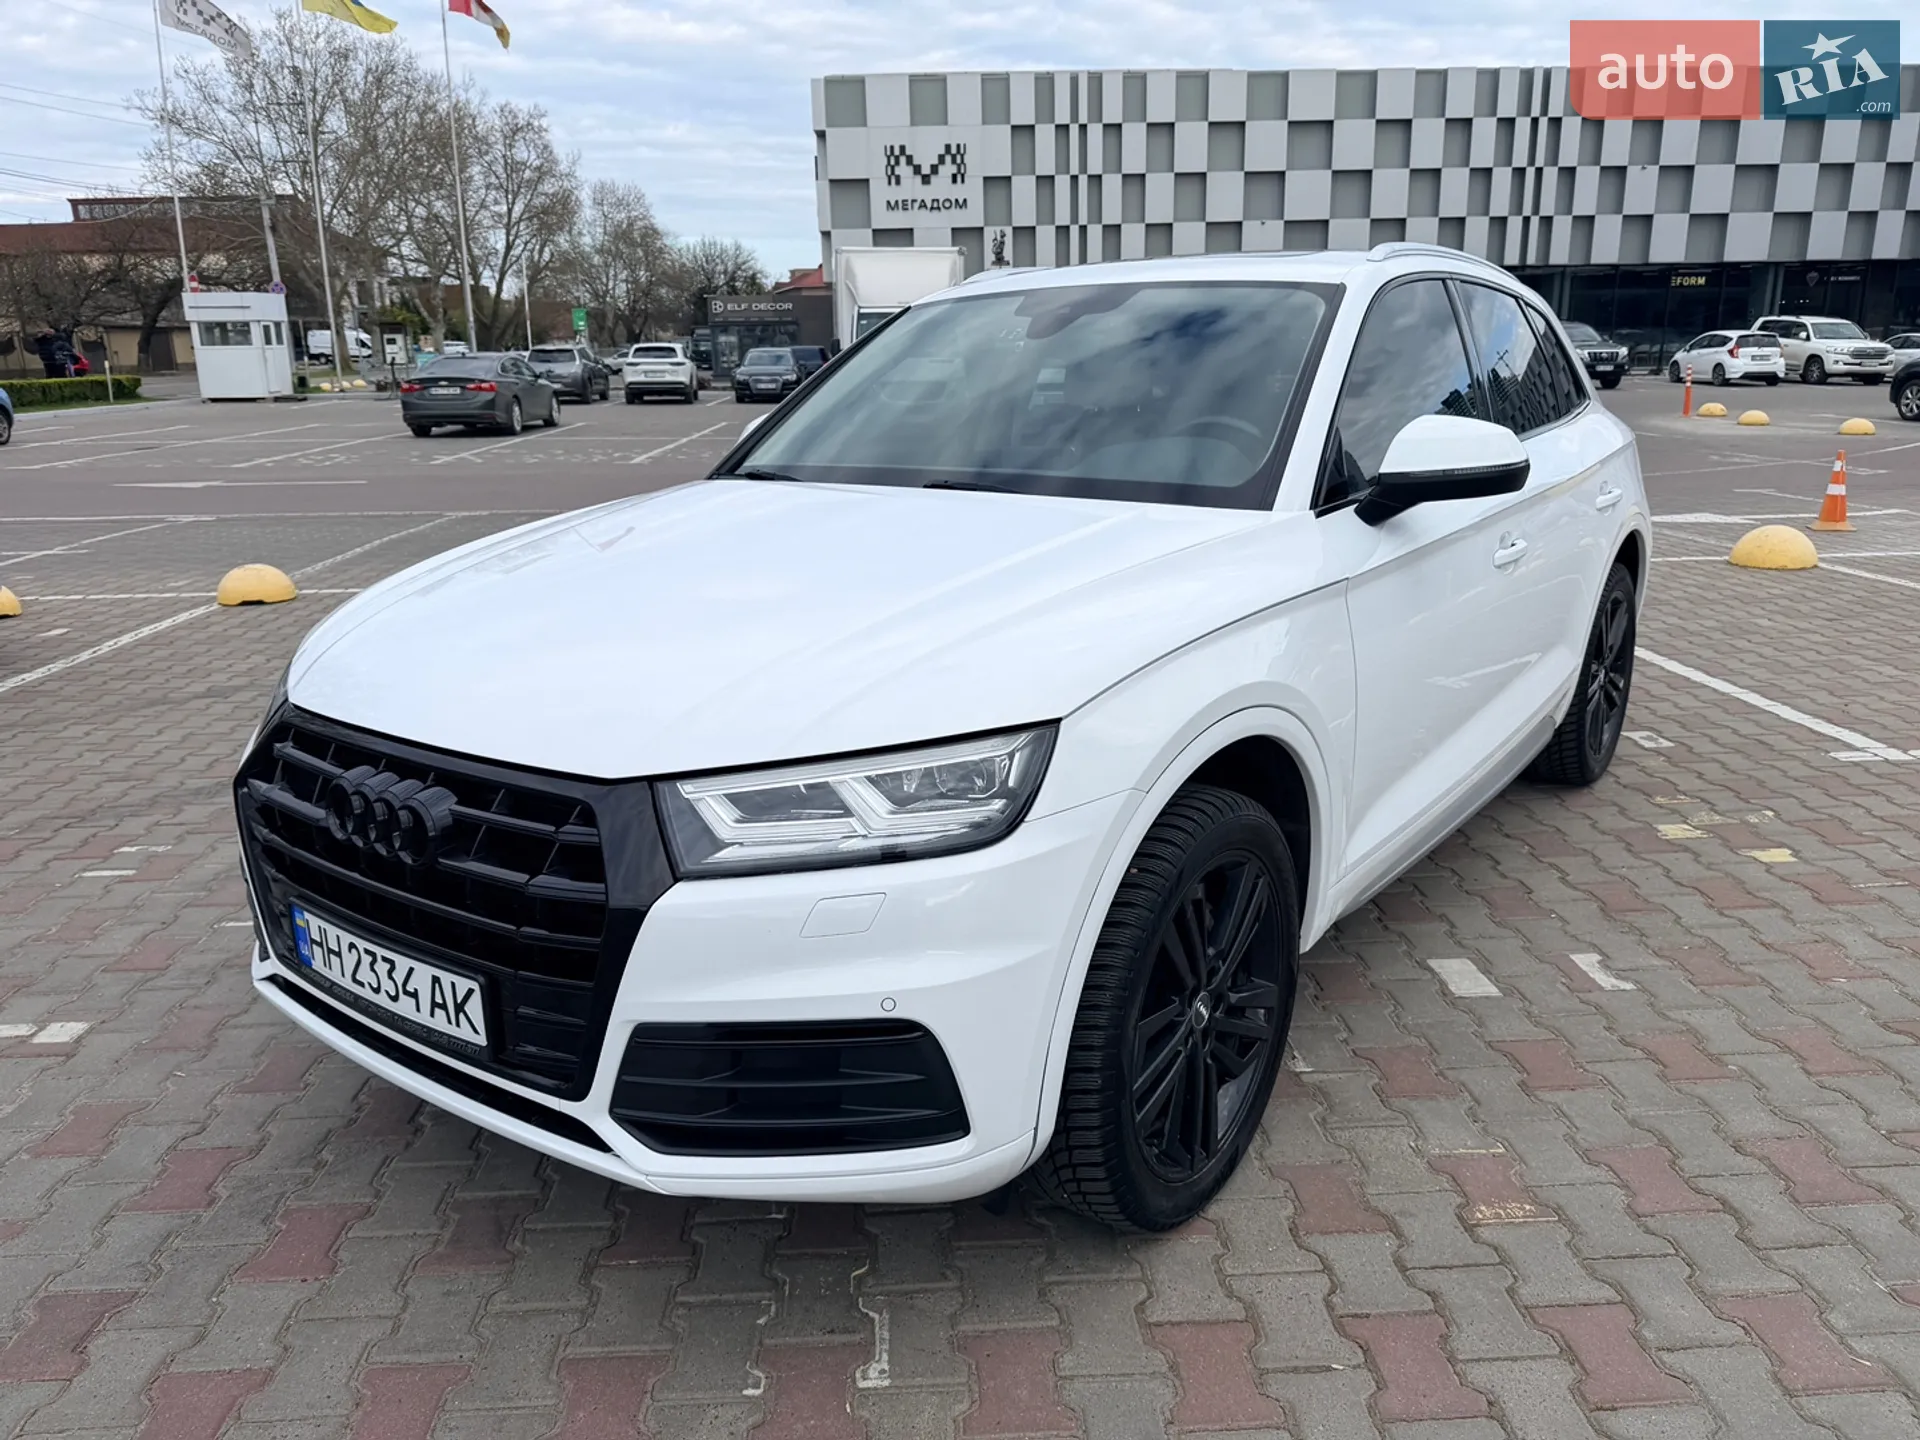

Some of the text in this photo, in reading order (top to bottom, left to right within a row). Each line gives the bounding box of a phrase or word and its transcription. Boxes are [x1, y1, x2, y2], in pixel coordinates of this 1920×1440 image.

[886, 197, 968, 213] МЕГАДОМ
[727, 302, 794, 311] ELF DECOR
